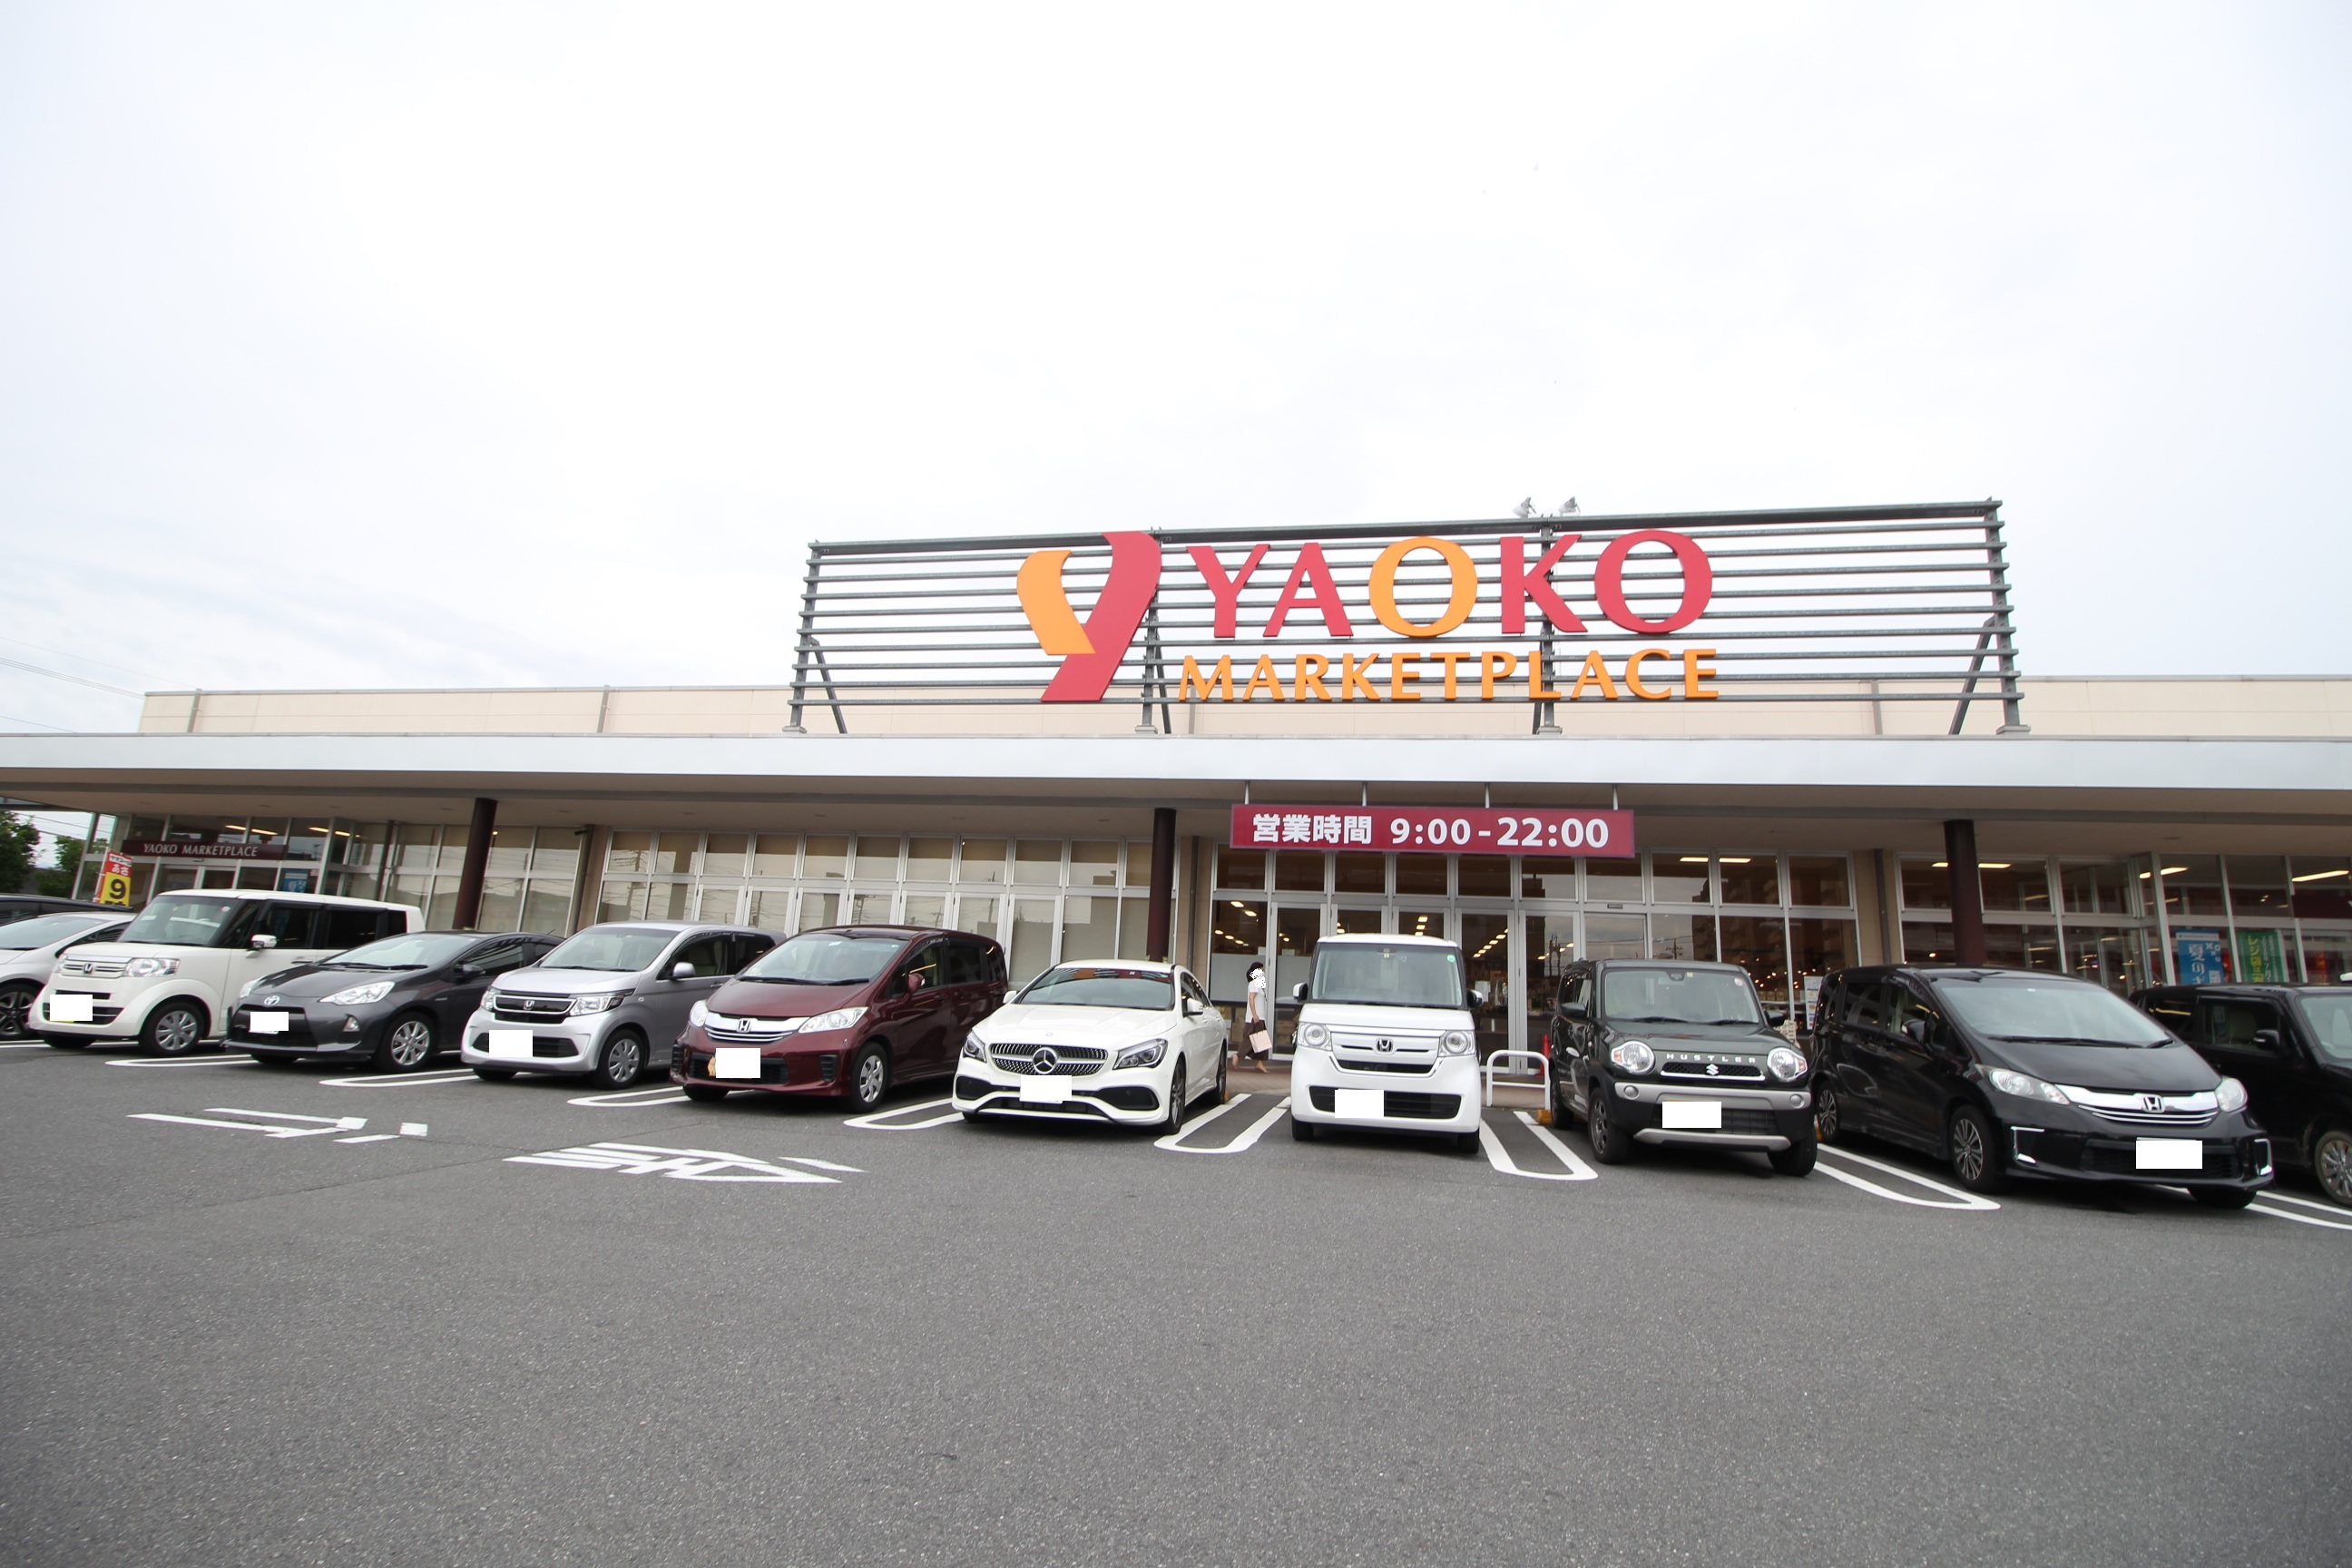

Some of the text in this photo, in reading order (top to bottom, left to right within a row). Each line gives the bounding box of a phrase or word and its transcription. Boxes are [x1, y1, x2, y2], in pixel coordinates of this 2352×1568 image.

[1185, 529, 1714, 638] YAOKO
[1179, 648, 1720, 701] MARKETPLACE
[1252, 813, 1372, 845] 営業時間
[143, 843, 258, 857] YAOKO MARKETPLACE
[111, 863, 130, 877] あさ
[109, 877, 128, 900] 9
[1666, 1054, 1756, 1063] HUSTLER
